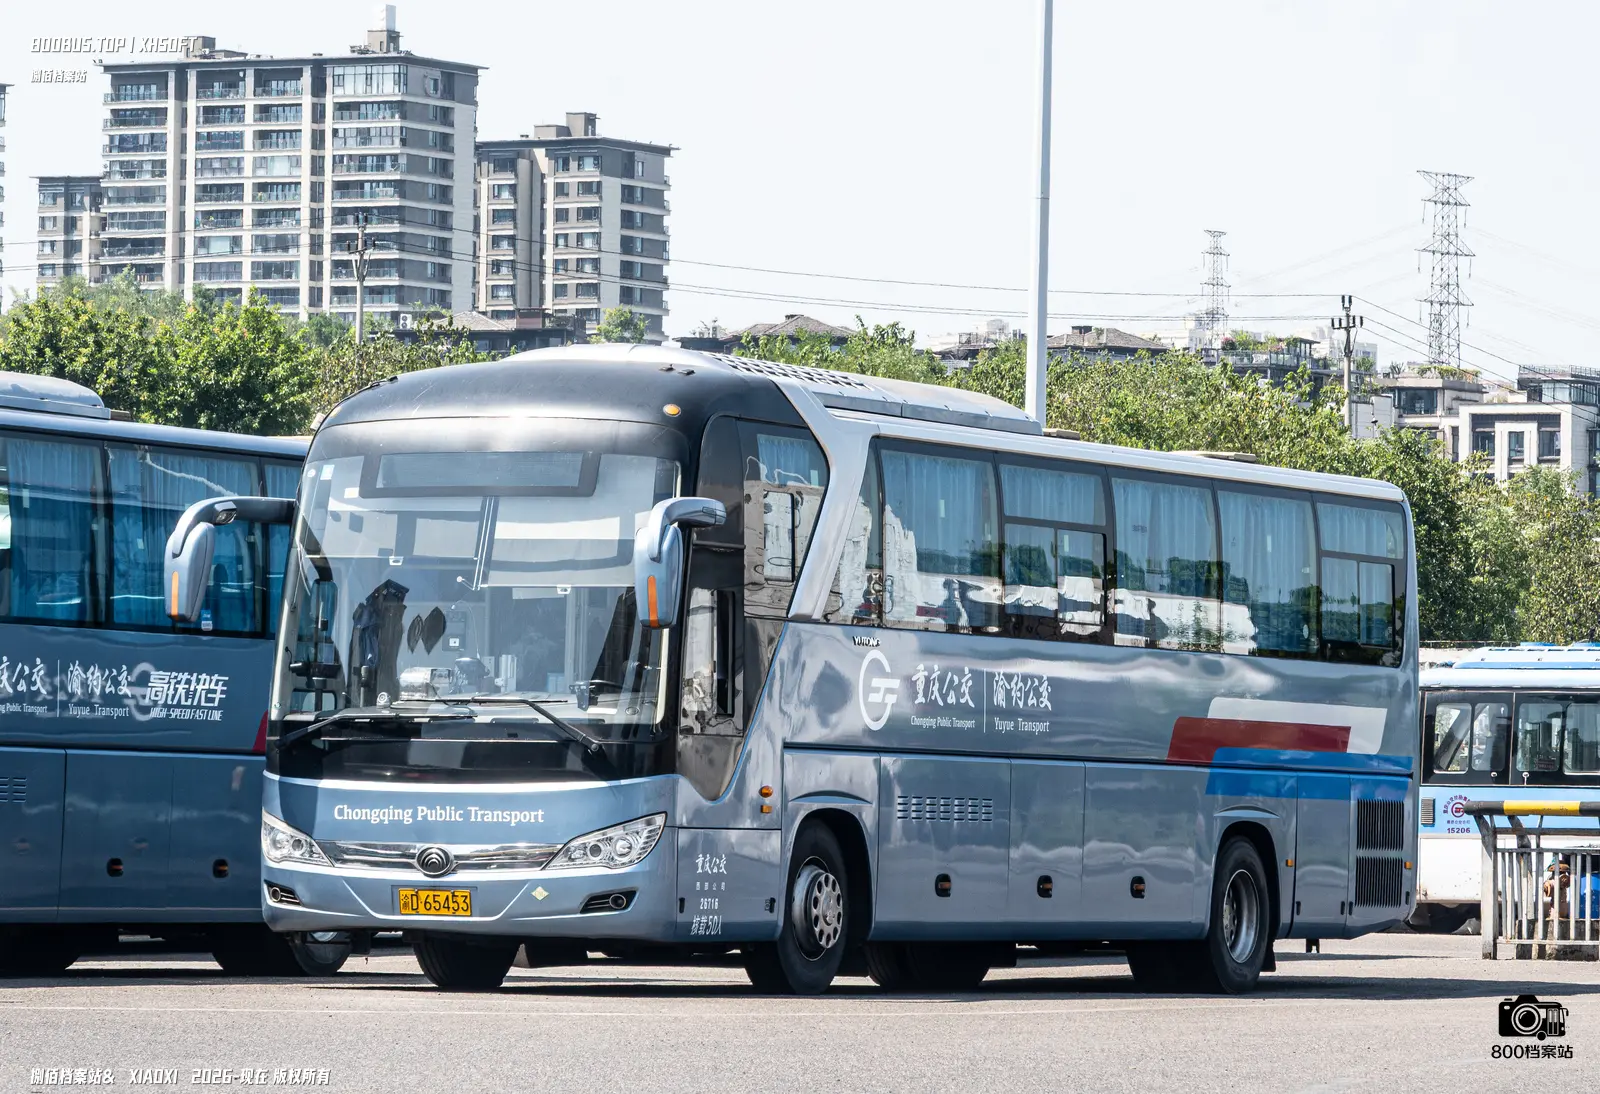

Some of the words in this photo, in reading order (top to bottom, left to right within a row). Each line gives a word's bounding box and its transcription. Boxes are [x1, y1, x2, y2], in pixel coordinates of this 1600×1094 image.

[852, 635, 881, 648] YUTONG
[144, 670, 229, 707] 高铁快车
[911, 663, 975, 708] 重庆公交
[23, 703, 48, 715] Transport
[68, 703, 90, 718] Yuyue
[94, 704, 129, 719] Transport
[190, 709, 208, 720] FAST
[207, 710, 224, 721] LINE
[911, 715, 936, 729] Chongqing
[937, 716, 952, 728] Public
[952, 717, 975, 731] Transport
[994, 717, 1014, 734] Yuyue
[1017, 717, 1050, 736] Transport
[334, 804, 413, 825] Chongqing
[417, 805, 464, 822] Public
[467, 806, 544, 826] Transport
[695, 854, 727, 875] 重庆公交
[699, 898, 719, 910] 26716
